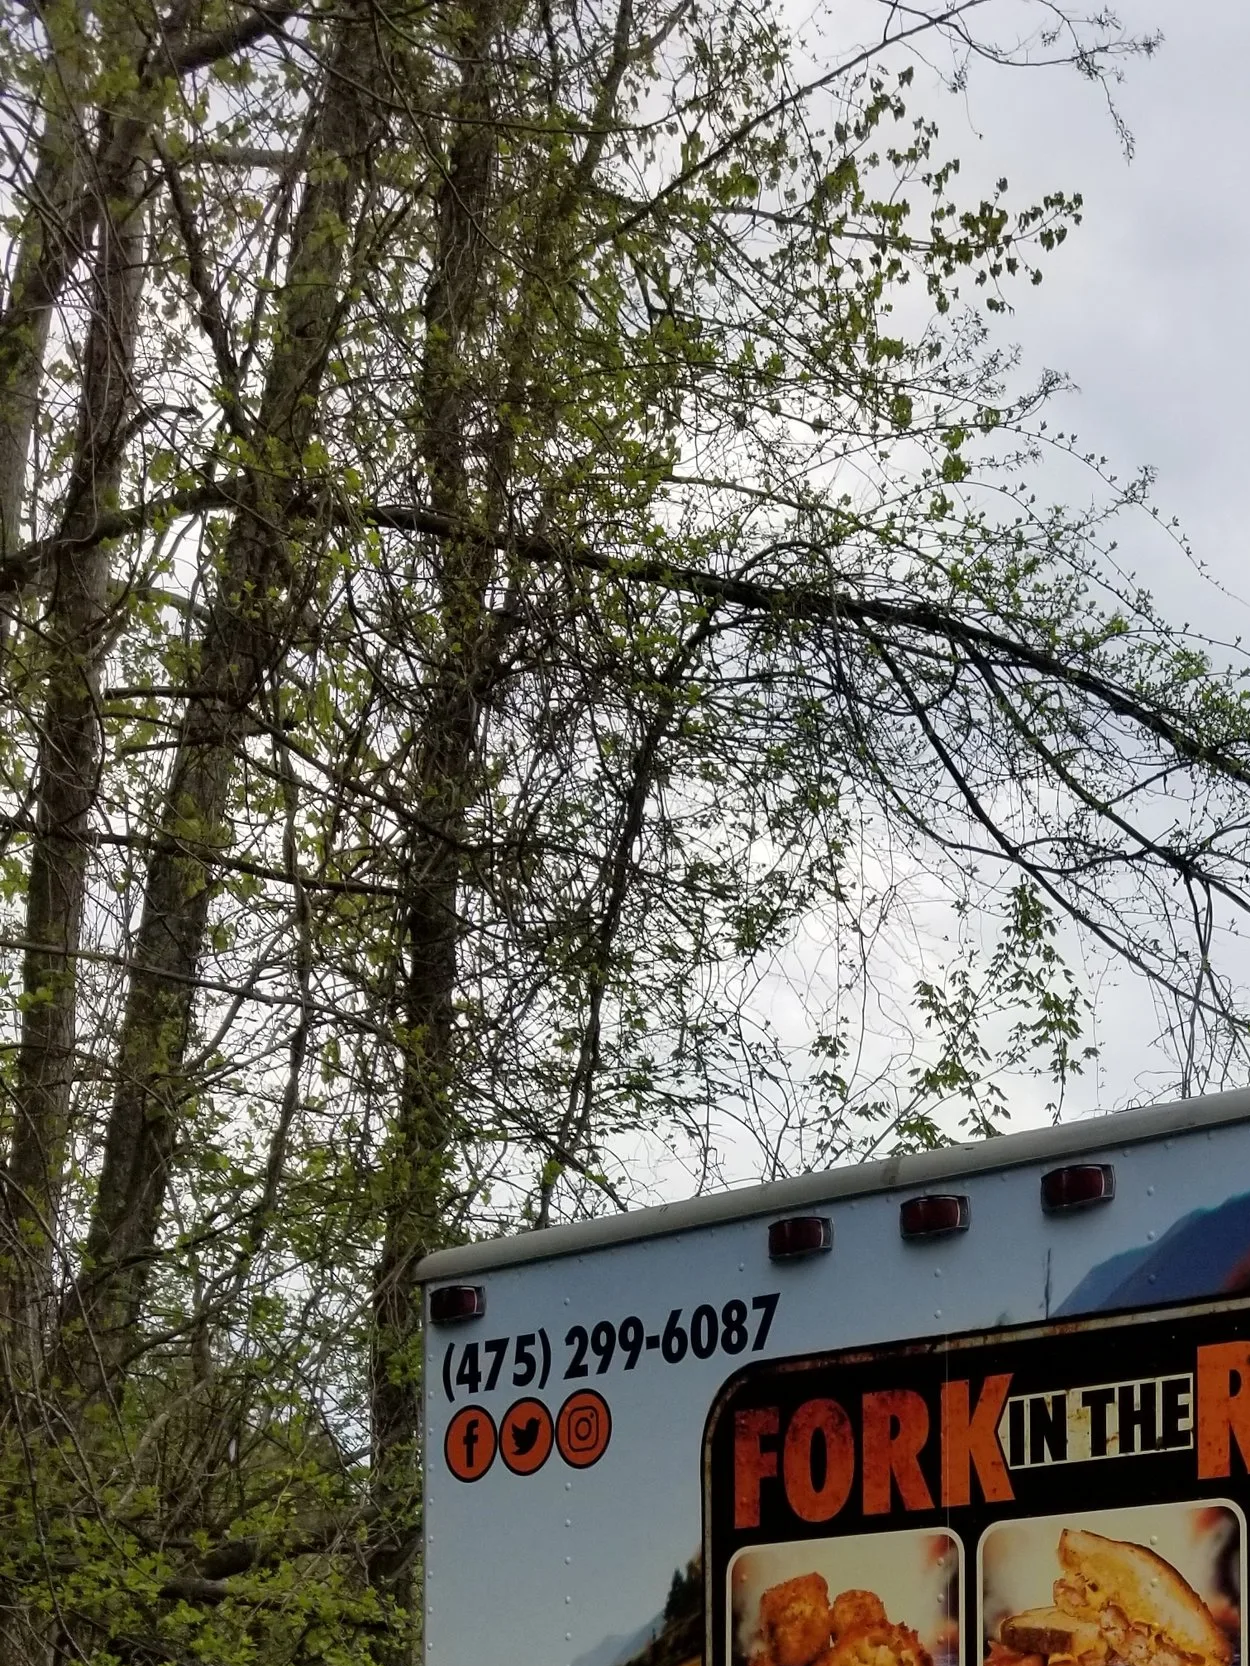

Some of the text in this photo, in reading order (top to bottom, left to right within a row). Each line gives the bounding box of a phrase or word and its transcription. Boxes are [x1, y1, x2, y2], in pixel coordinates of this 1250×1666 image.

[442, 1293, 780, 1402] (475) 299-6087
[733, 1373, 1015, 1529] FORK
[1008, 1394, 1067, 1466] IN
[1081, 1377, 1191, 1457] THE
